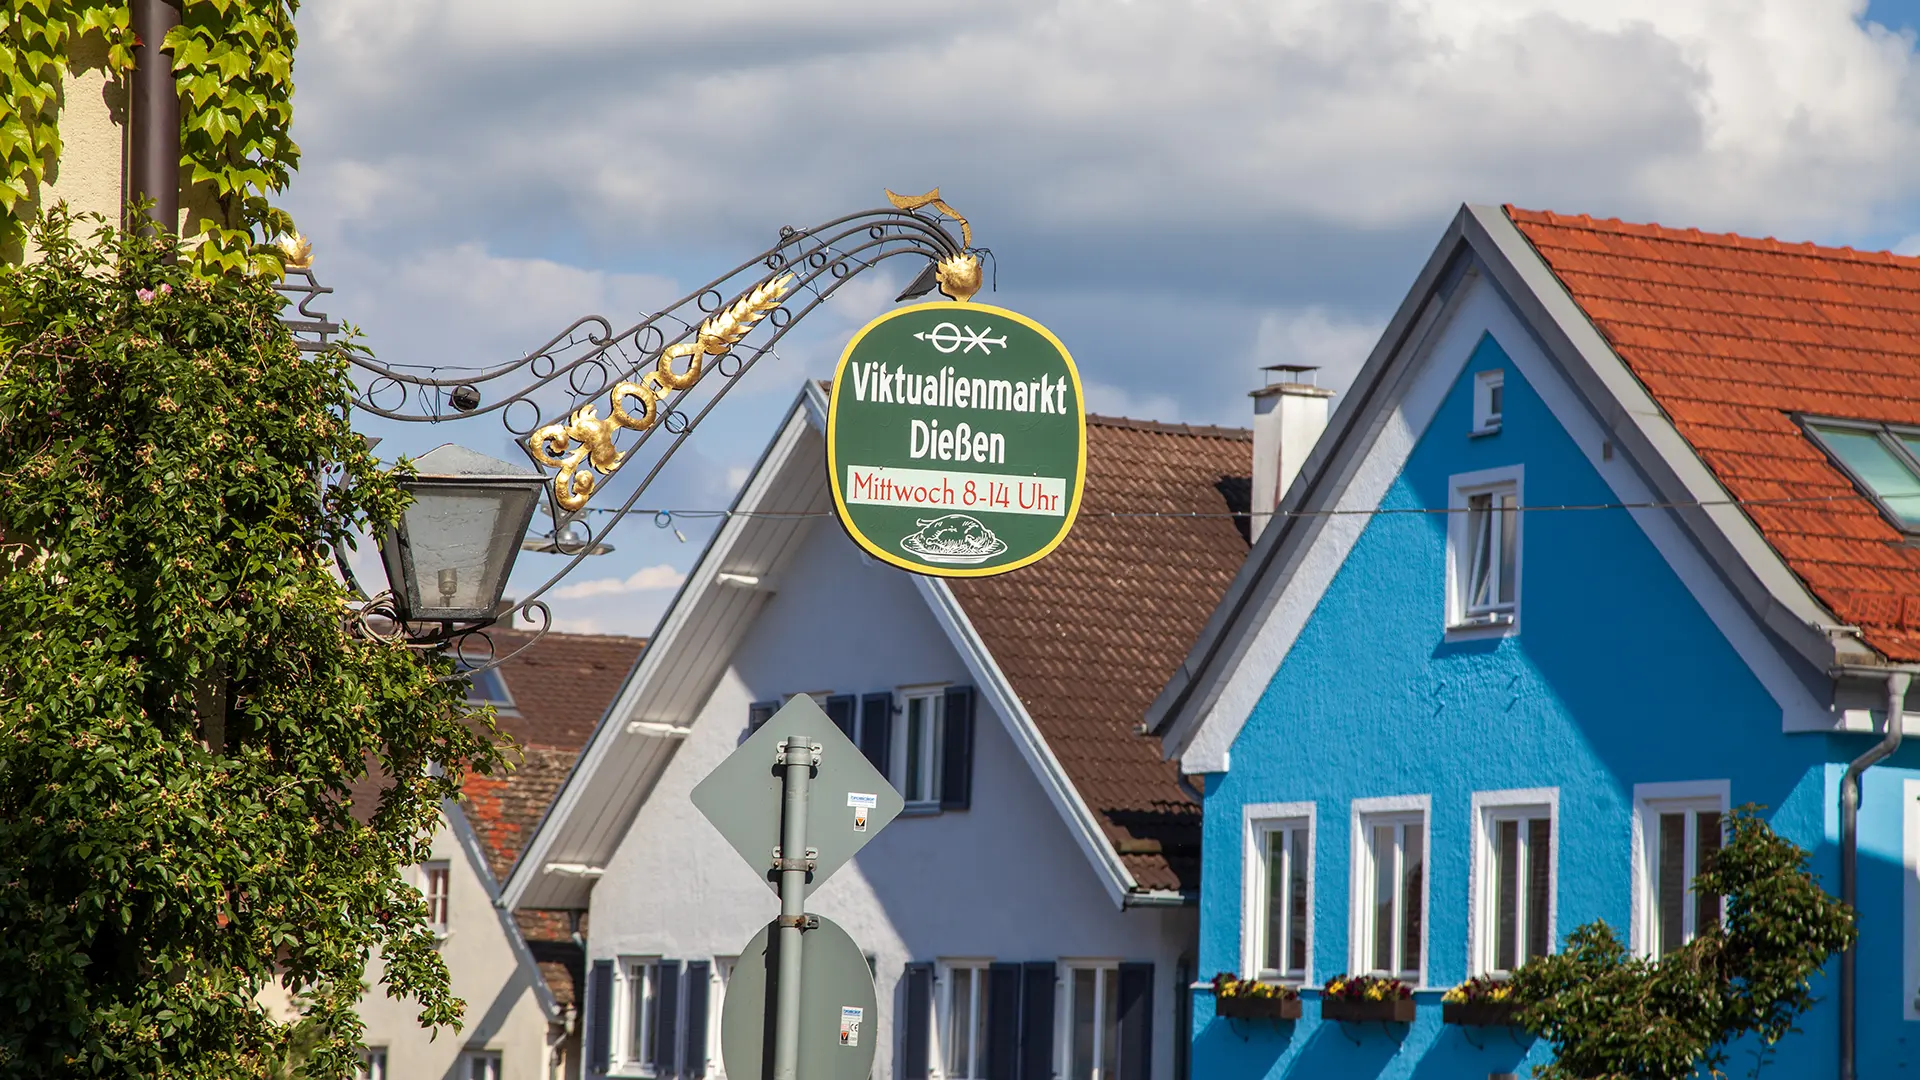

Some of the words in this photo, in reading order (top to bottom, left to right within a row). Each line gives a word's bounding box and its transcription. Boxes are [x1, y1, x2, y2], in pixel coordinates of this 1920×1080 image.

[852, 361, 1067, 414] Viktualienmarkt
[910, 419, 1005, 464] Dießen
[853, 472, 955, 504] Mittwoch
[962, 480, 1010, 508] 8-14
[1018, 482, 1058, 511] Uhr
